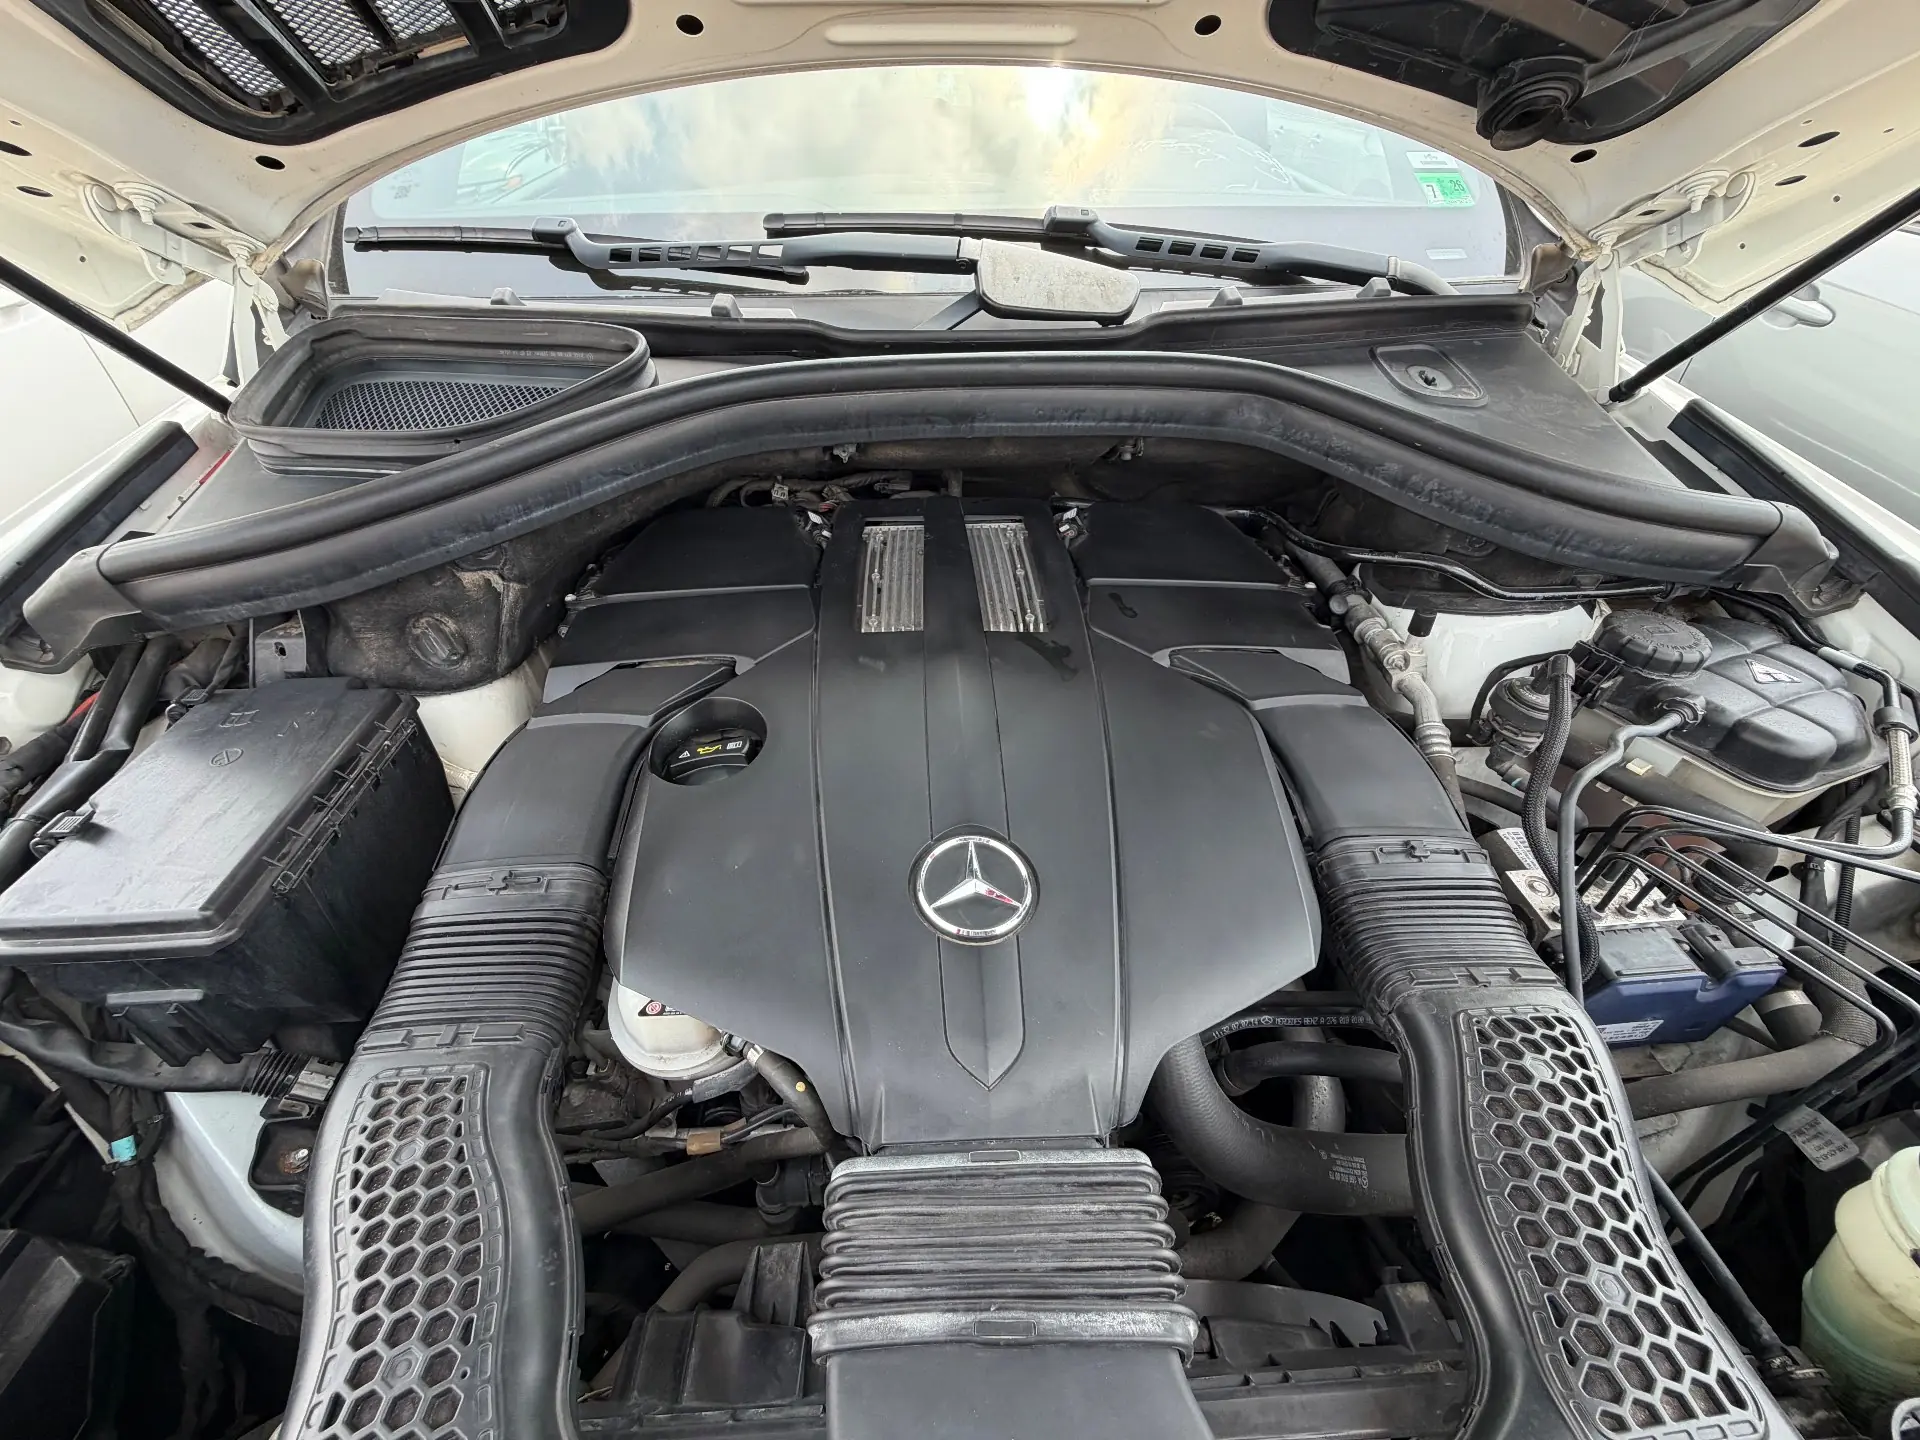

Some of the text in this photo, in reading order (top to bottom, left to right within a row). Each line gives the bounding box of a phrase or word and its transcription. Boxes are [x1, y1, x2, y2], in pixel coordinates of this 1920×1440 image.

[1426, 184, 1437, 198] 7
[1448, 179, 1466, 192] 26
[1275, 1017, 1301, 1026] MERCEDES
